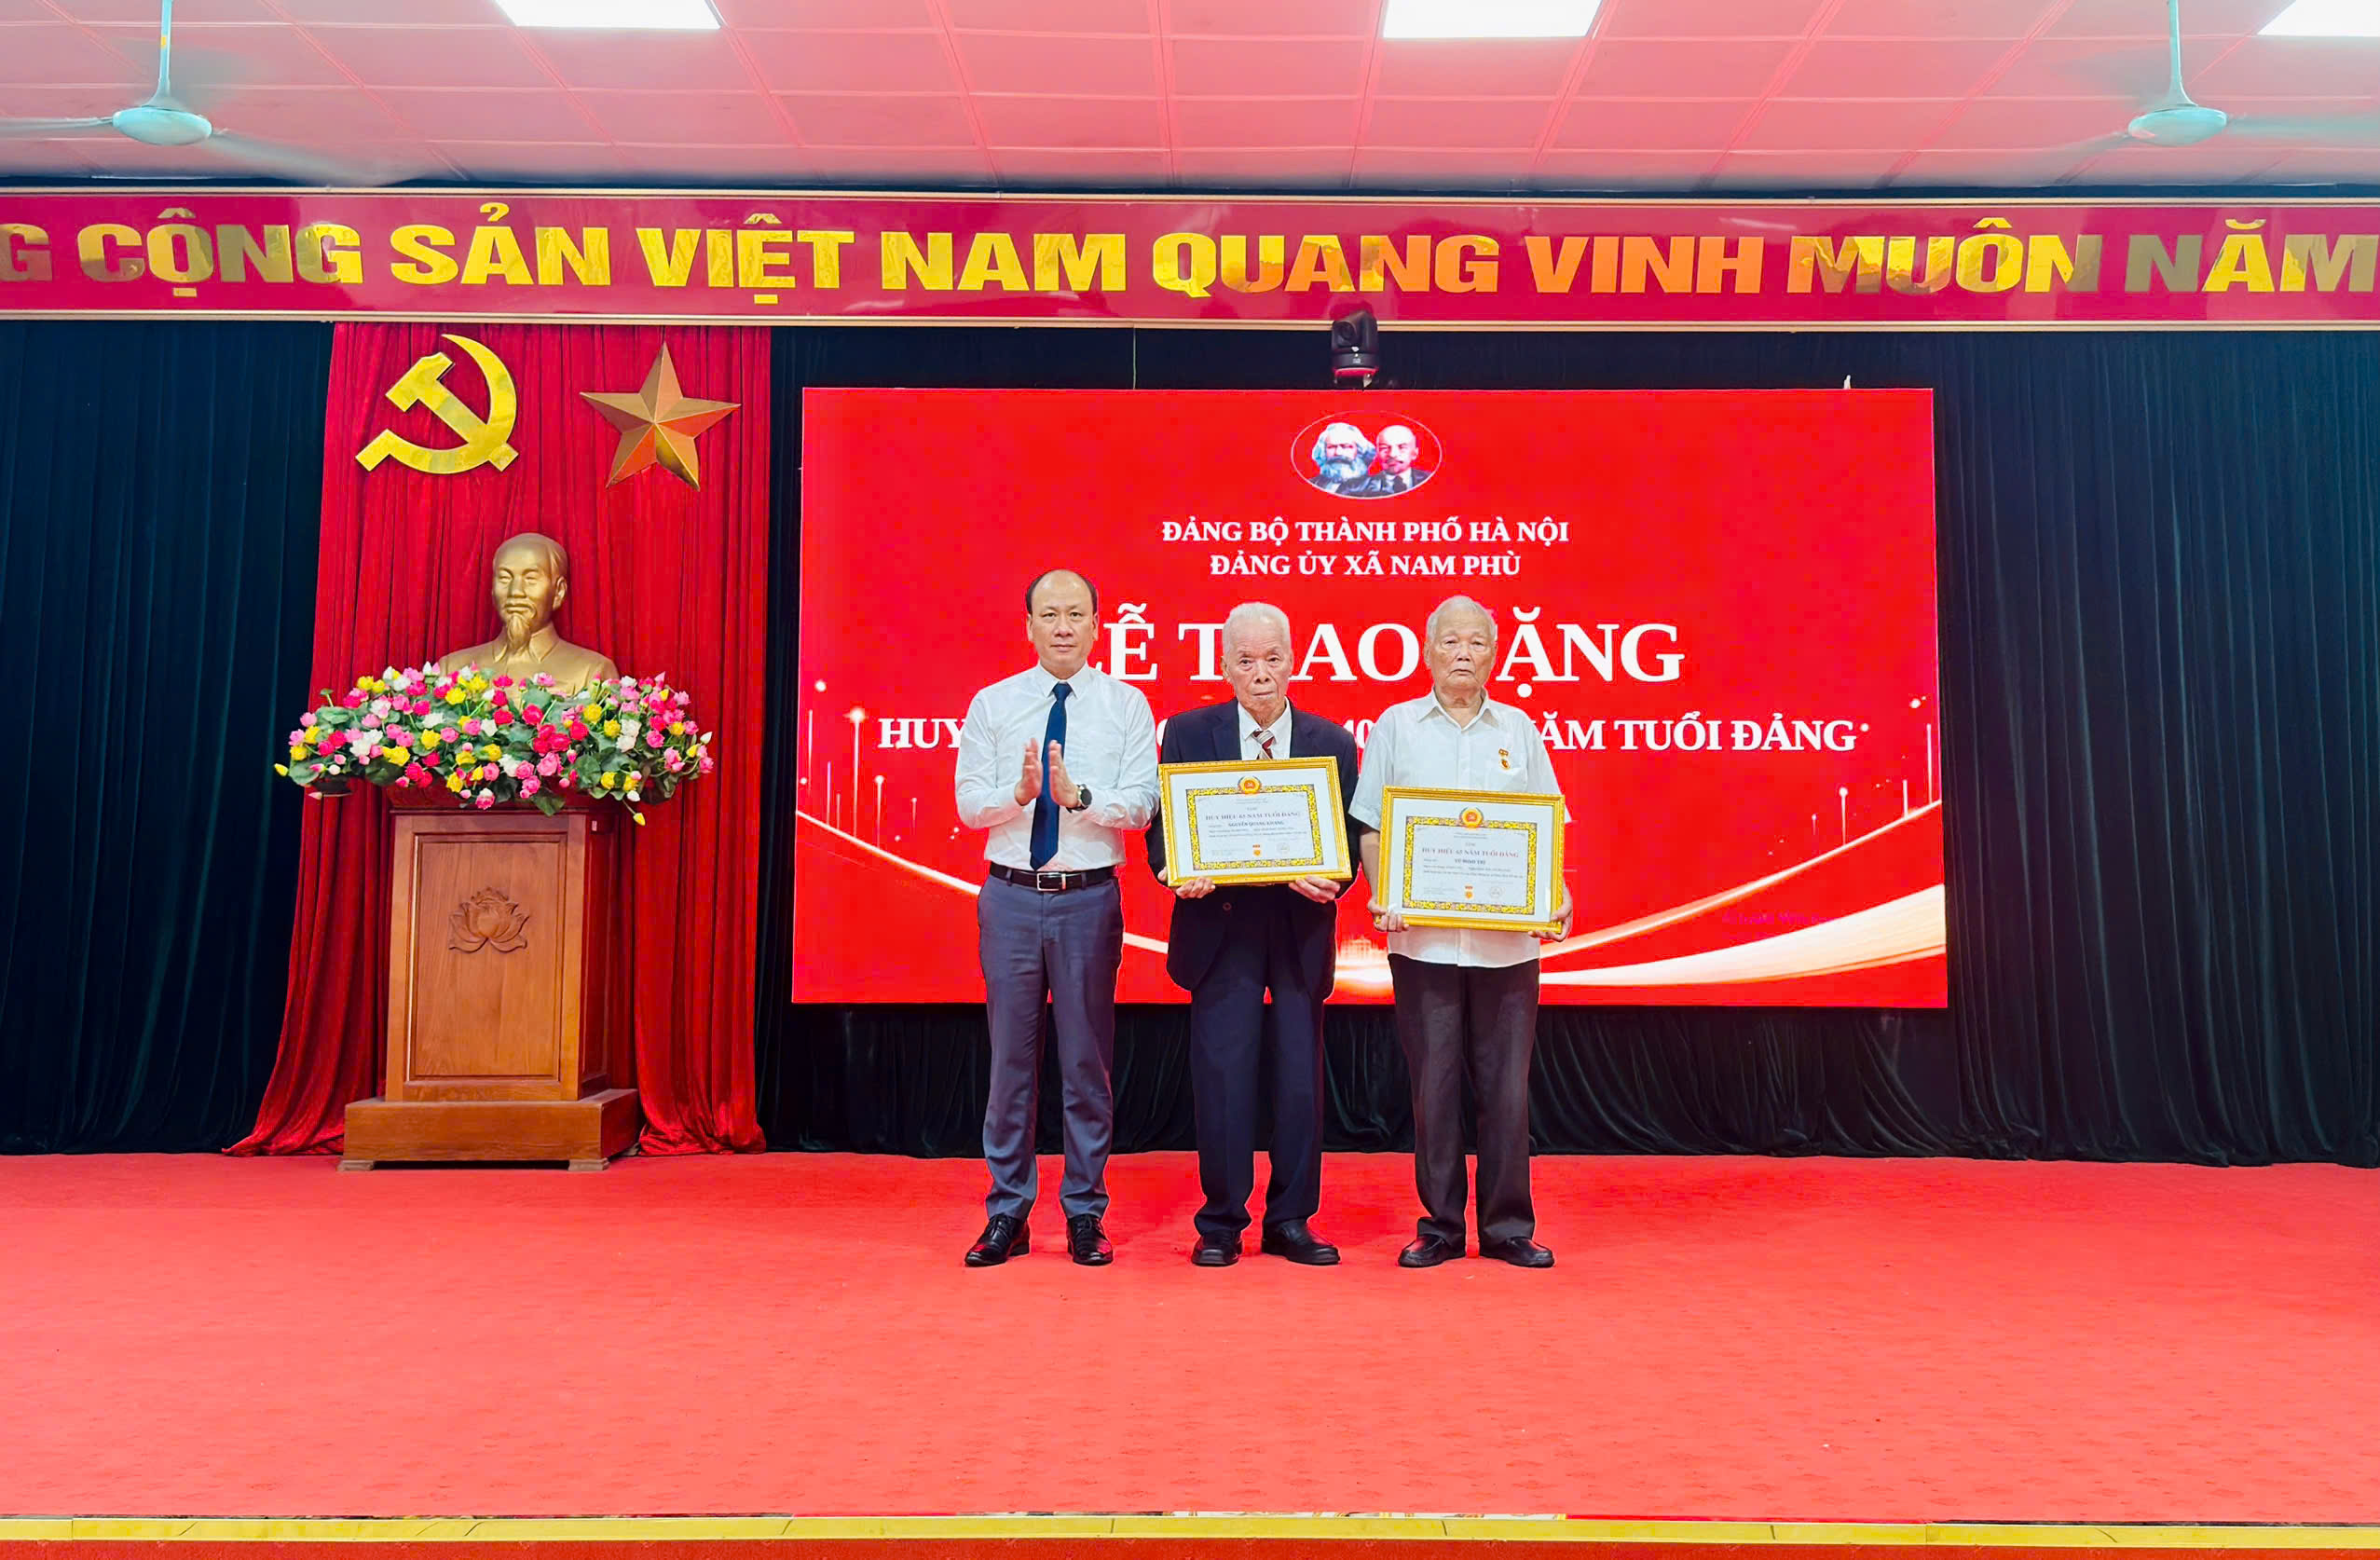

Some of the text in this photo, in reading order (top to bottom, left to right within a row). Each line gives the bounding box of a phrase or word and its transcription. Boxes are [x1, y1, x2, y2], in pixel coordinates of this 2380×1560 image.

[77, 208, 364, 297] CỘNG
[390, 202, 612, 286] SẢN
[636, 212, 855, 305] VIỆT
[881, 231, 1127, 293] NAM
[1152, 232, 1499, 297] QUANG
[1525, 235, 1763, 294] VINH
[1787, 216, 2102, 294] MUÔN
[2123, 219, 2379, 294] NĂM
[1162, 515, 1569, 546] ĐẢNG BỘ THÀNH PHỐ HÀ NỘI
[1210, 550, 1521, 575] ĐẢNG ỦY XÃ NAM PHÙ
[1094, 603, 1686, 697] Ễ TAO ẶNG
[877, 718, 966, 749] HUY
[1532, 711, 1606, 750] ĂM
[1614, 710, 1723, 751] TUỔI
[1730, 712, 1857, 751] ĐẢNG
